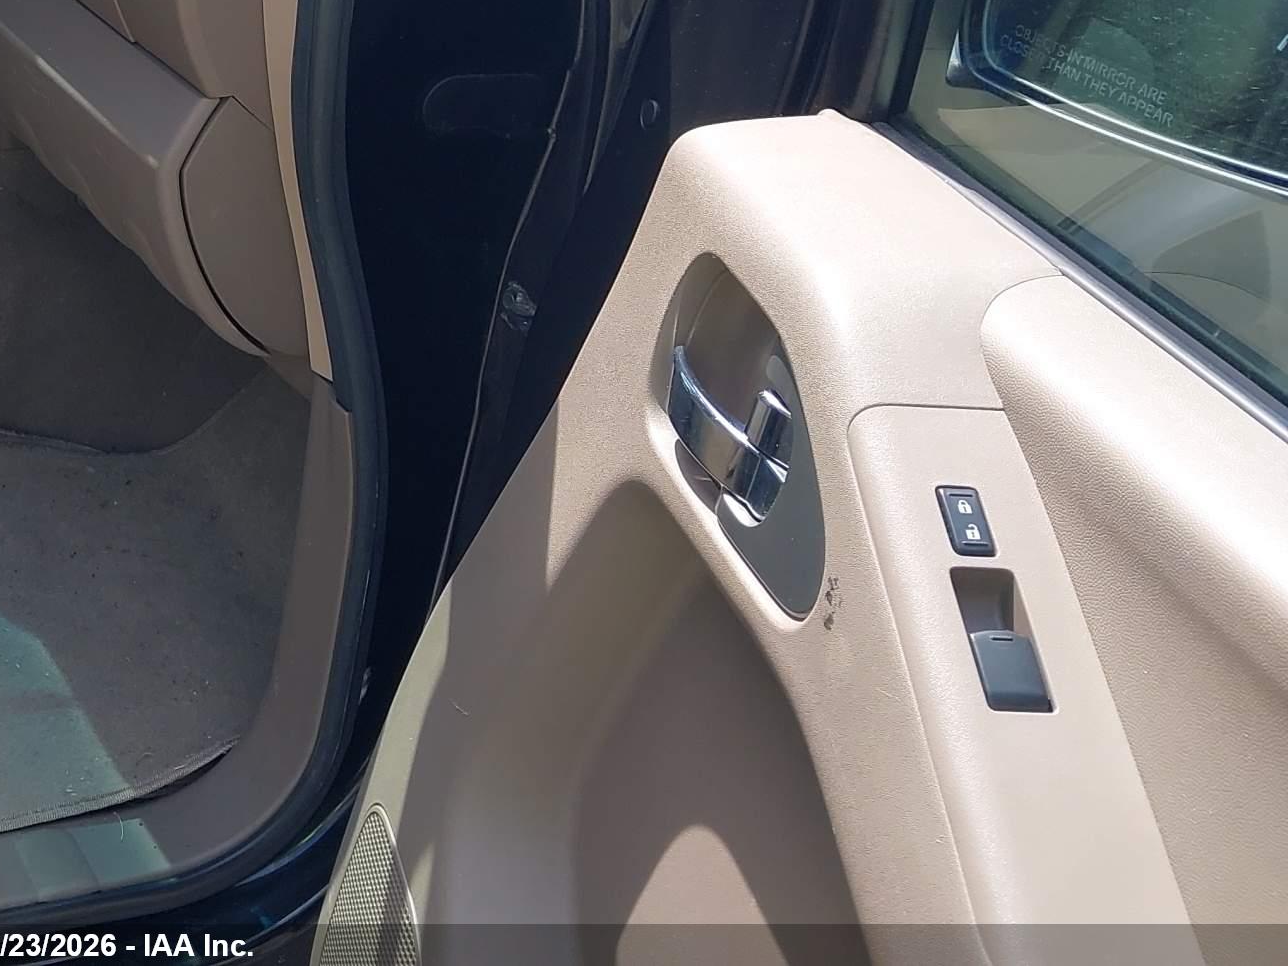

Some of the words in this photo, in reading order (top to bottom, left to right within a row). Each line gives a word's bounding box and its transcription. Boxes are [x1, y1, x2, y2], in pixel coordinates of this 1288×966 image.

[1014, 24, 1067, 58] OBJECTS
[1066, 48, 1082, 66] IN
[1082, 55, 1136, 91] MIRROR
[1137, 82, 1169, 106] ARE
[1046, 56, 1083, 83] THAN
[1083, 72, 1119, 98] THEY
[1117, 90, 1175, 128] APPEAR
